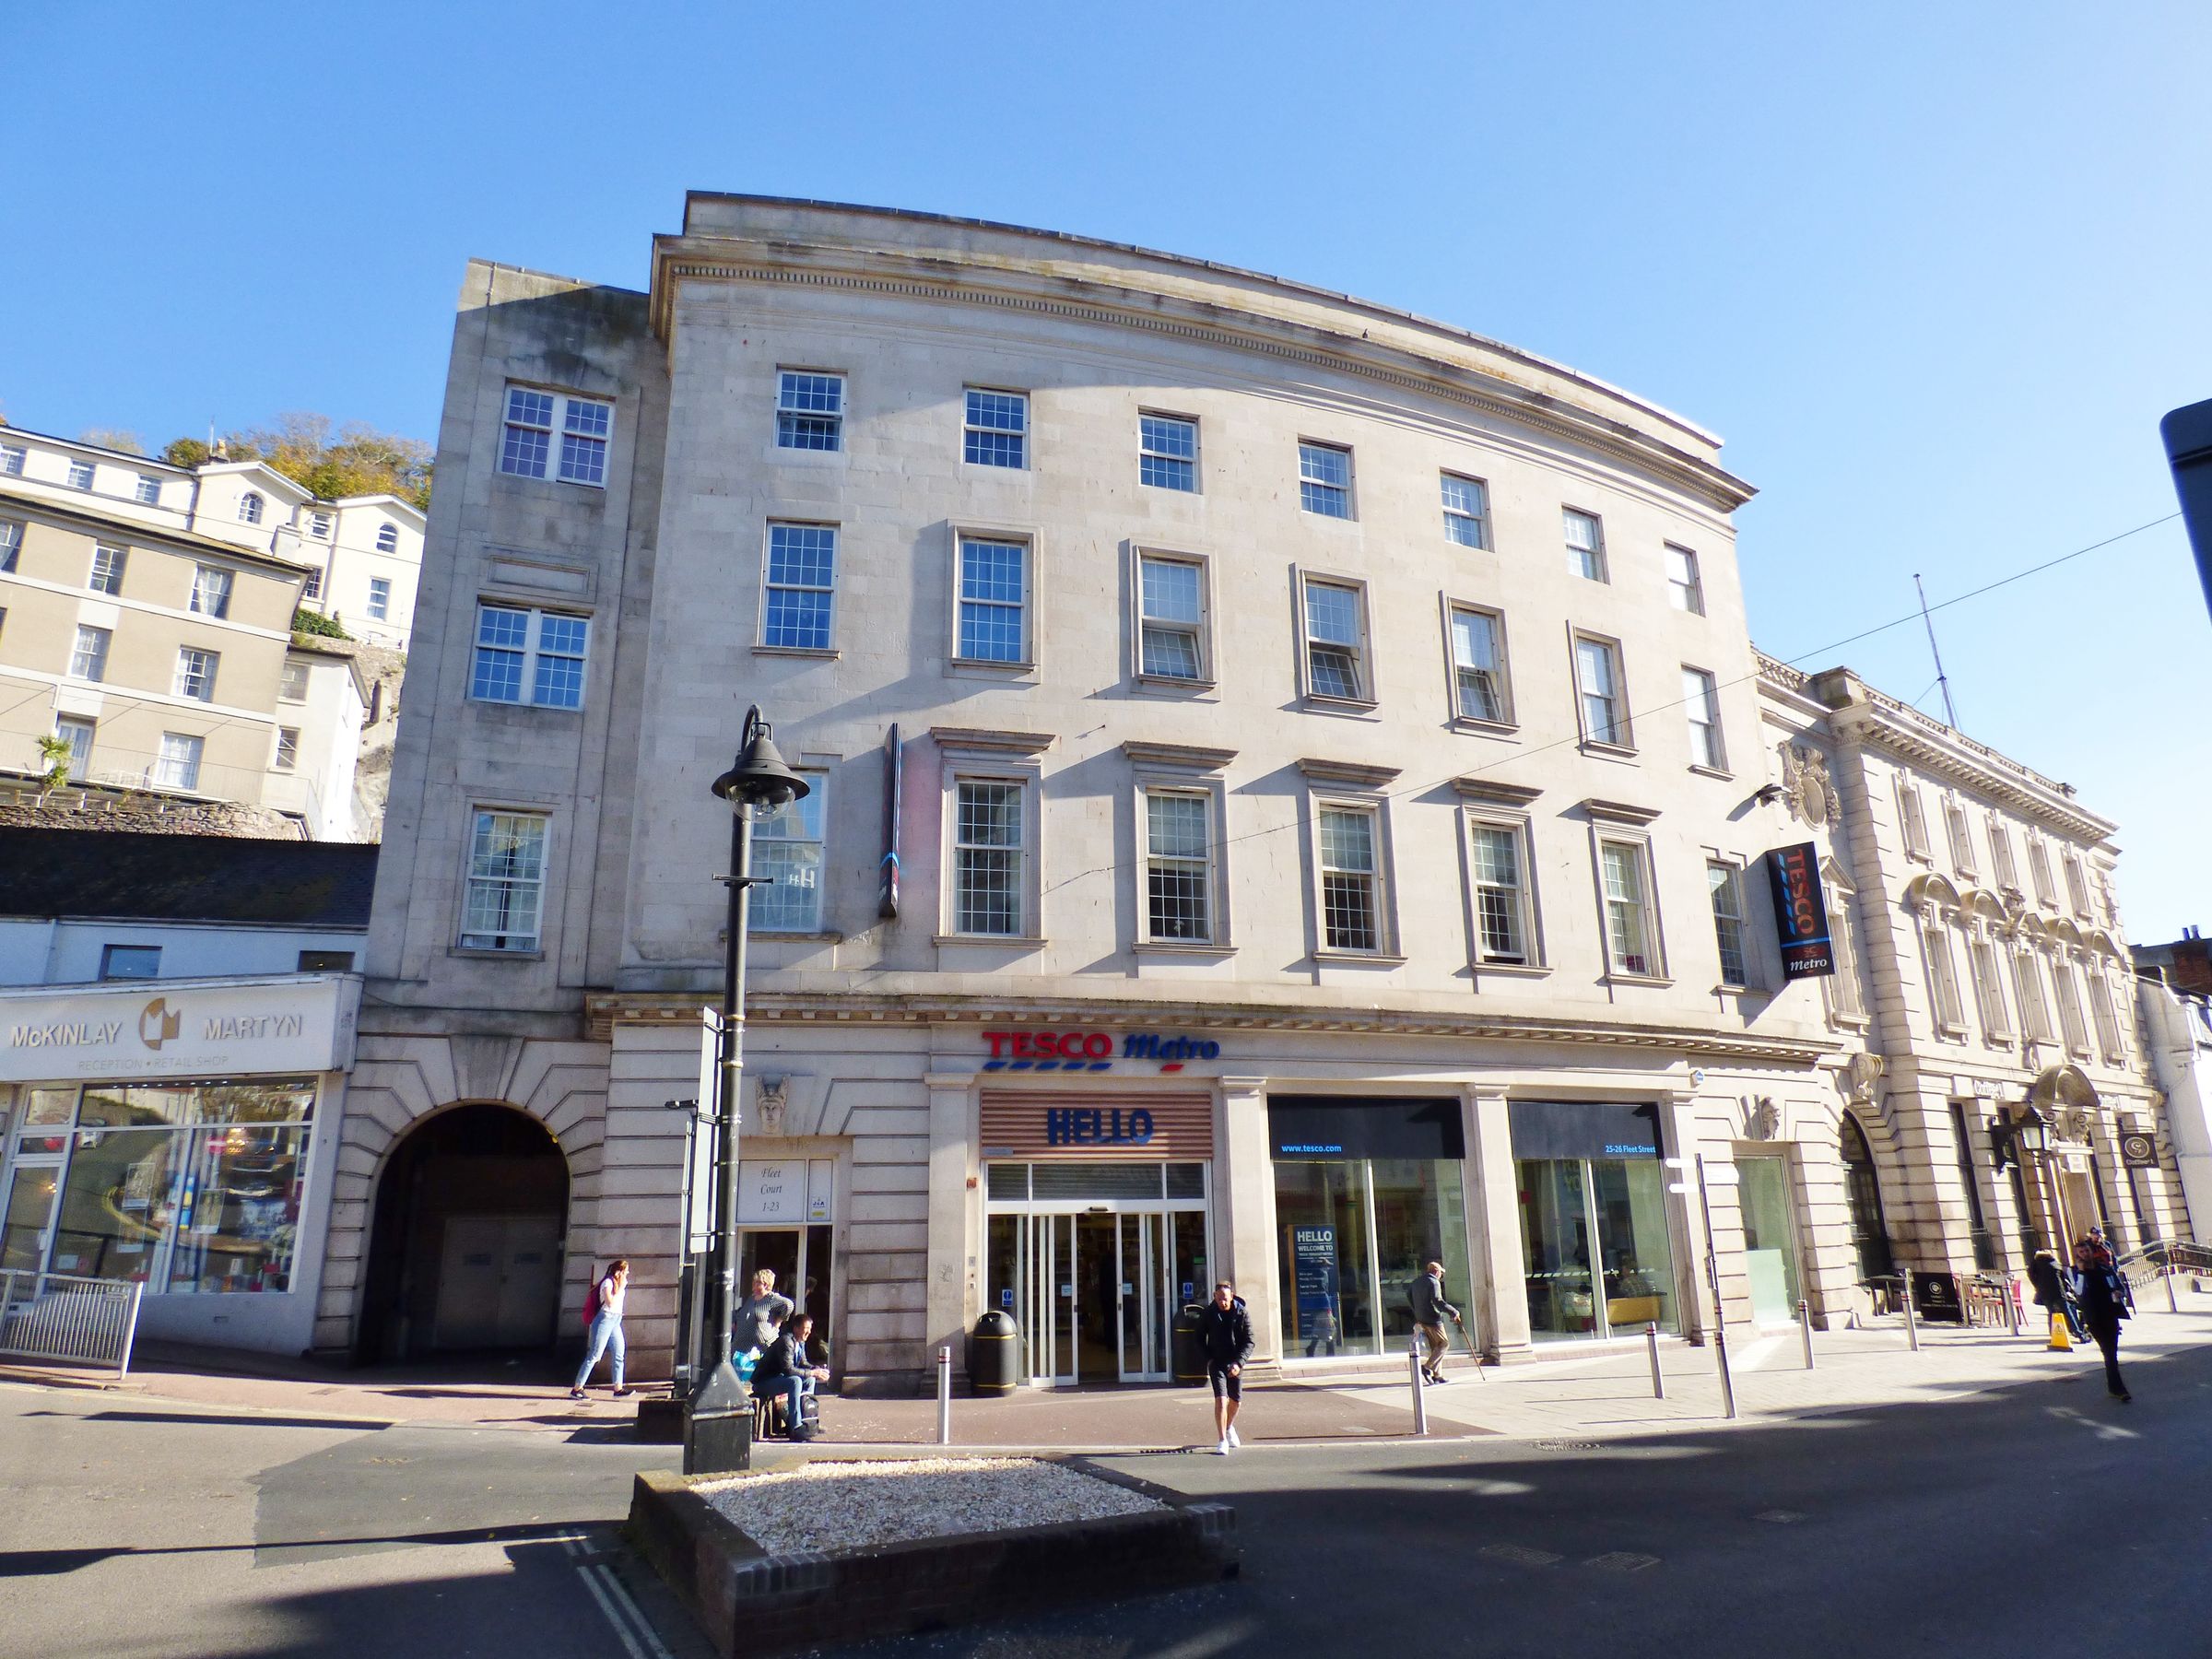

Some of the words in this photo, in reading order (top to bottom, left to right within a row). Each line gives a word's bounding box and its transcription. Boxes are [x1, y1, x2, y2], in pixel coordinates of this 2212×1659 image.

[1786, 848, 1816, 935] TESCO
[11, 1021, 123, 1048] McKINLAY
[206, 1014, 302, 1041] MARTYN
[982, 1032, 1113, 1059] TESCO
[79, 1059, 143, 1070] RECEPTION
[154, 1057, 192, 1068] RETAIL
[196, 1056, 229, 1066] SHOP
[1047, 1107, 1153, 1146] HELLO
[761, 1166, 781, 1178] Fleet
[760, 1184, 782, 1195] Court
[762, 1201, 780, 1212] 1-23
[1297, 1230, 1333, 1242] HELLO
